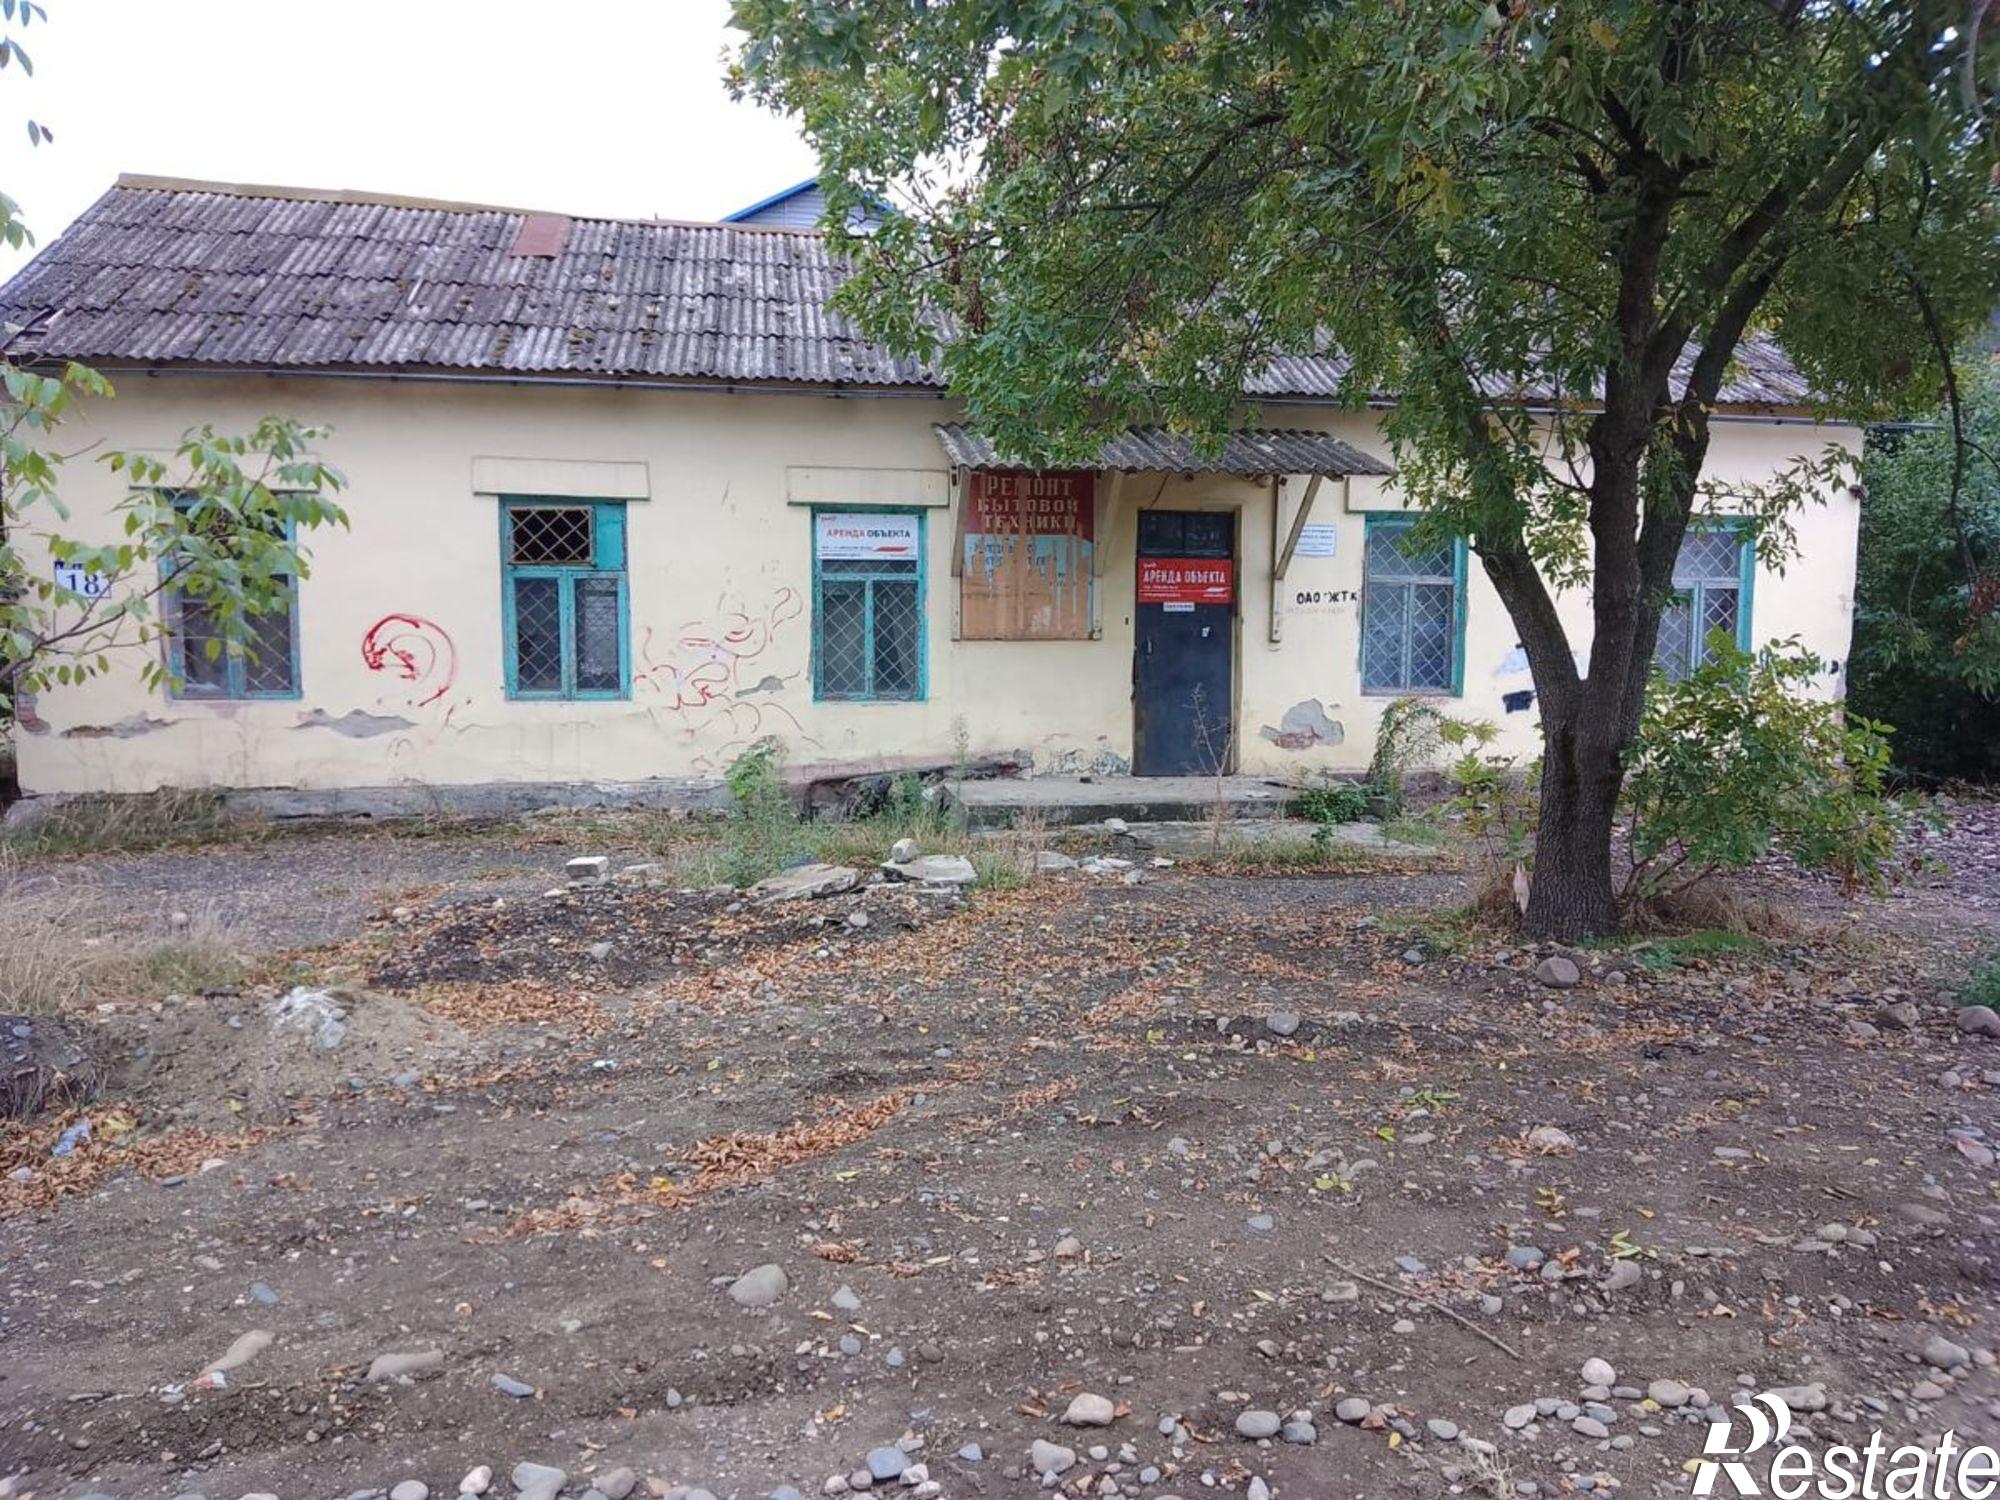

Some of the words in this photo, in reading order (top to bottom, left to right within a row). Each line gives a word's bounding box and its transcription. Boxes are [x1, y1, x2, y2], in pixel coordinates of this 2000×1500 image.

[827, 528, 866, 540] АРЕНДА
[866, 529, 911, 538] ОБЪЕКТА
[1143, 569, 1182, 585] АРЕНДА
[1184, 570, 1226, 584] ОБЪЕКТА
[66, 574, 99, 595] 18
[1296, 591, 1321, 604] ОАО
